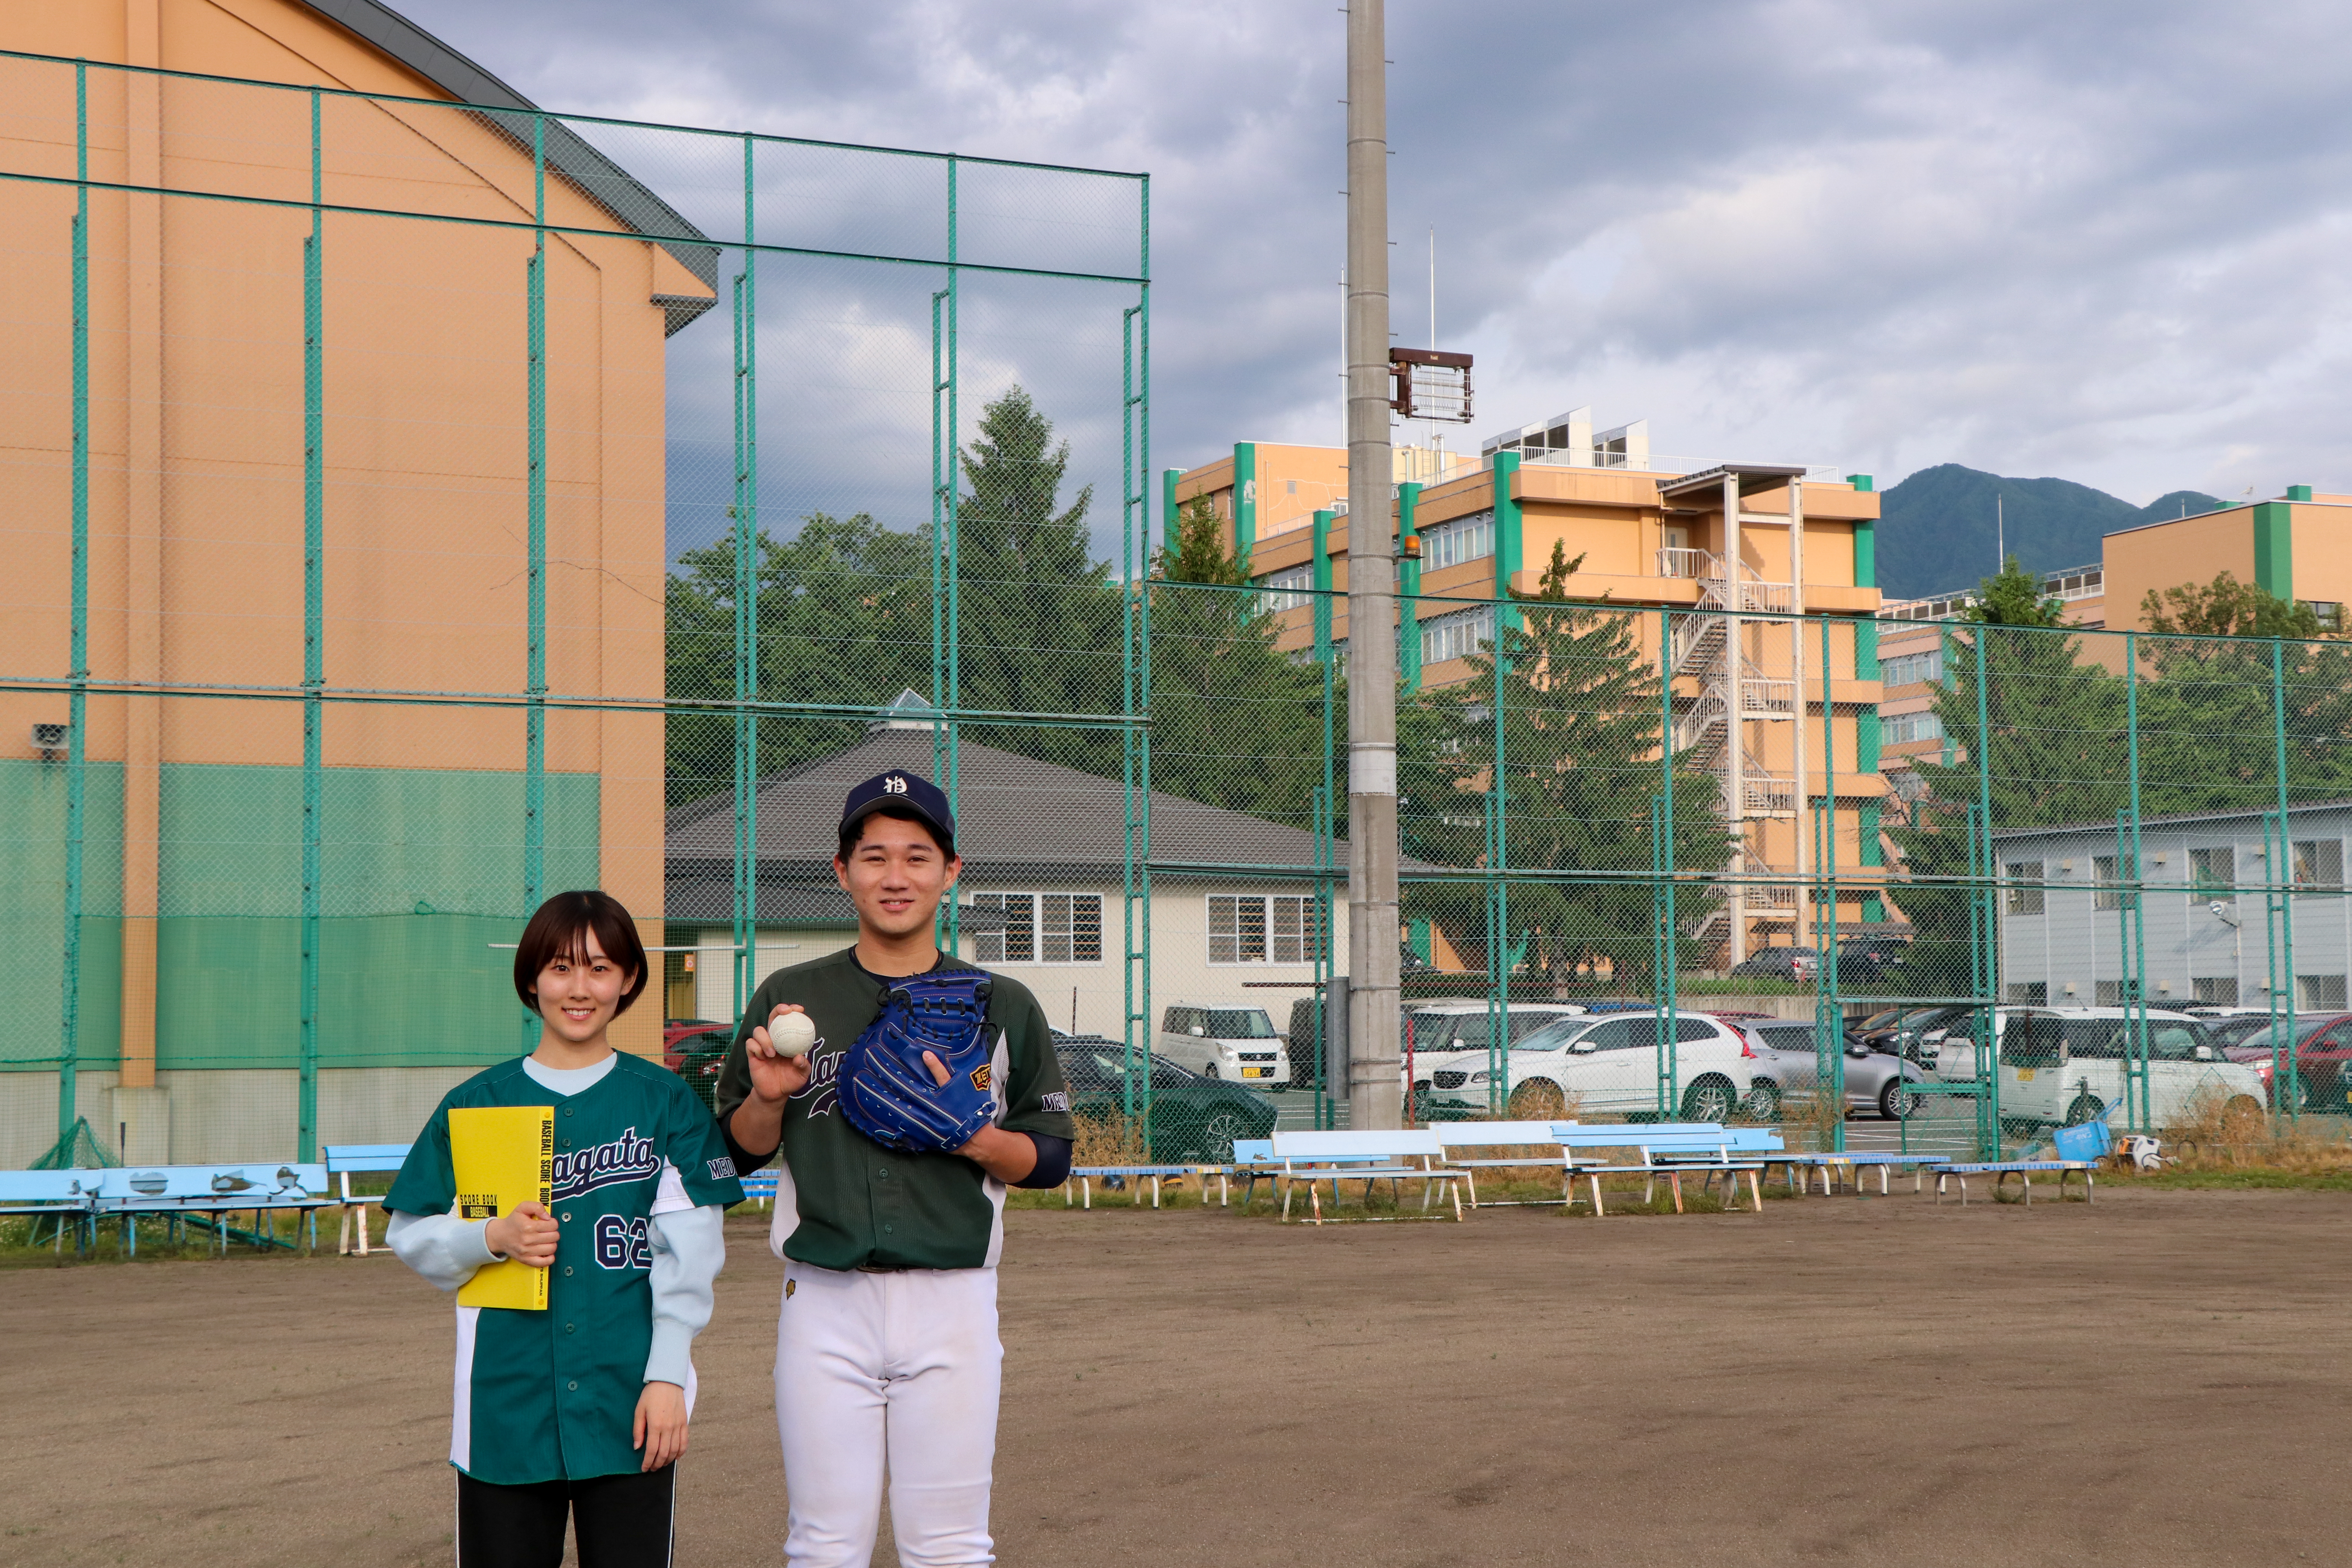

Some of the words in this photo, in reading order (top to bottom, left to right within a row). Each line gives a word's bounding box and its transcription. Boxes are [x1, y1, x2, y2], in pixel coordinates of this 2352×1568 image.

[541, 1120, 552, 1157] BASEBALL
[540, 1159, 551, 1183] SCORE
[460, 1194, 479, 1205] SCORE
[483, 1194, 497, 1205] BOOK
[470, 1206, 490, 1218] BASEBALL
[594, 1214, 652, 1270] 62
